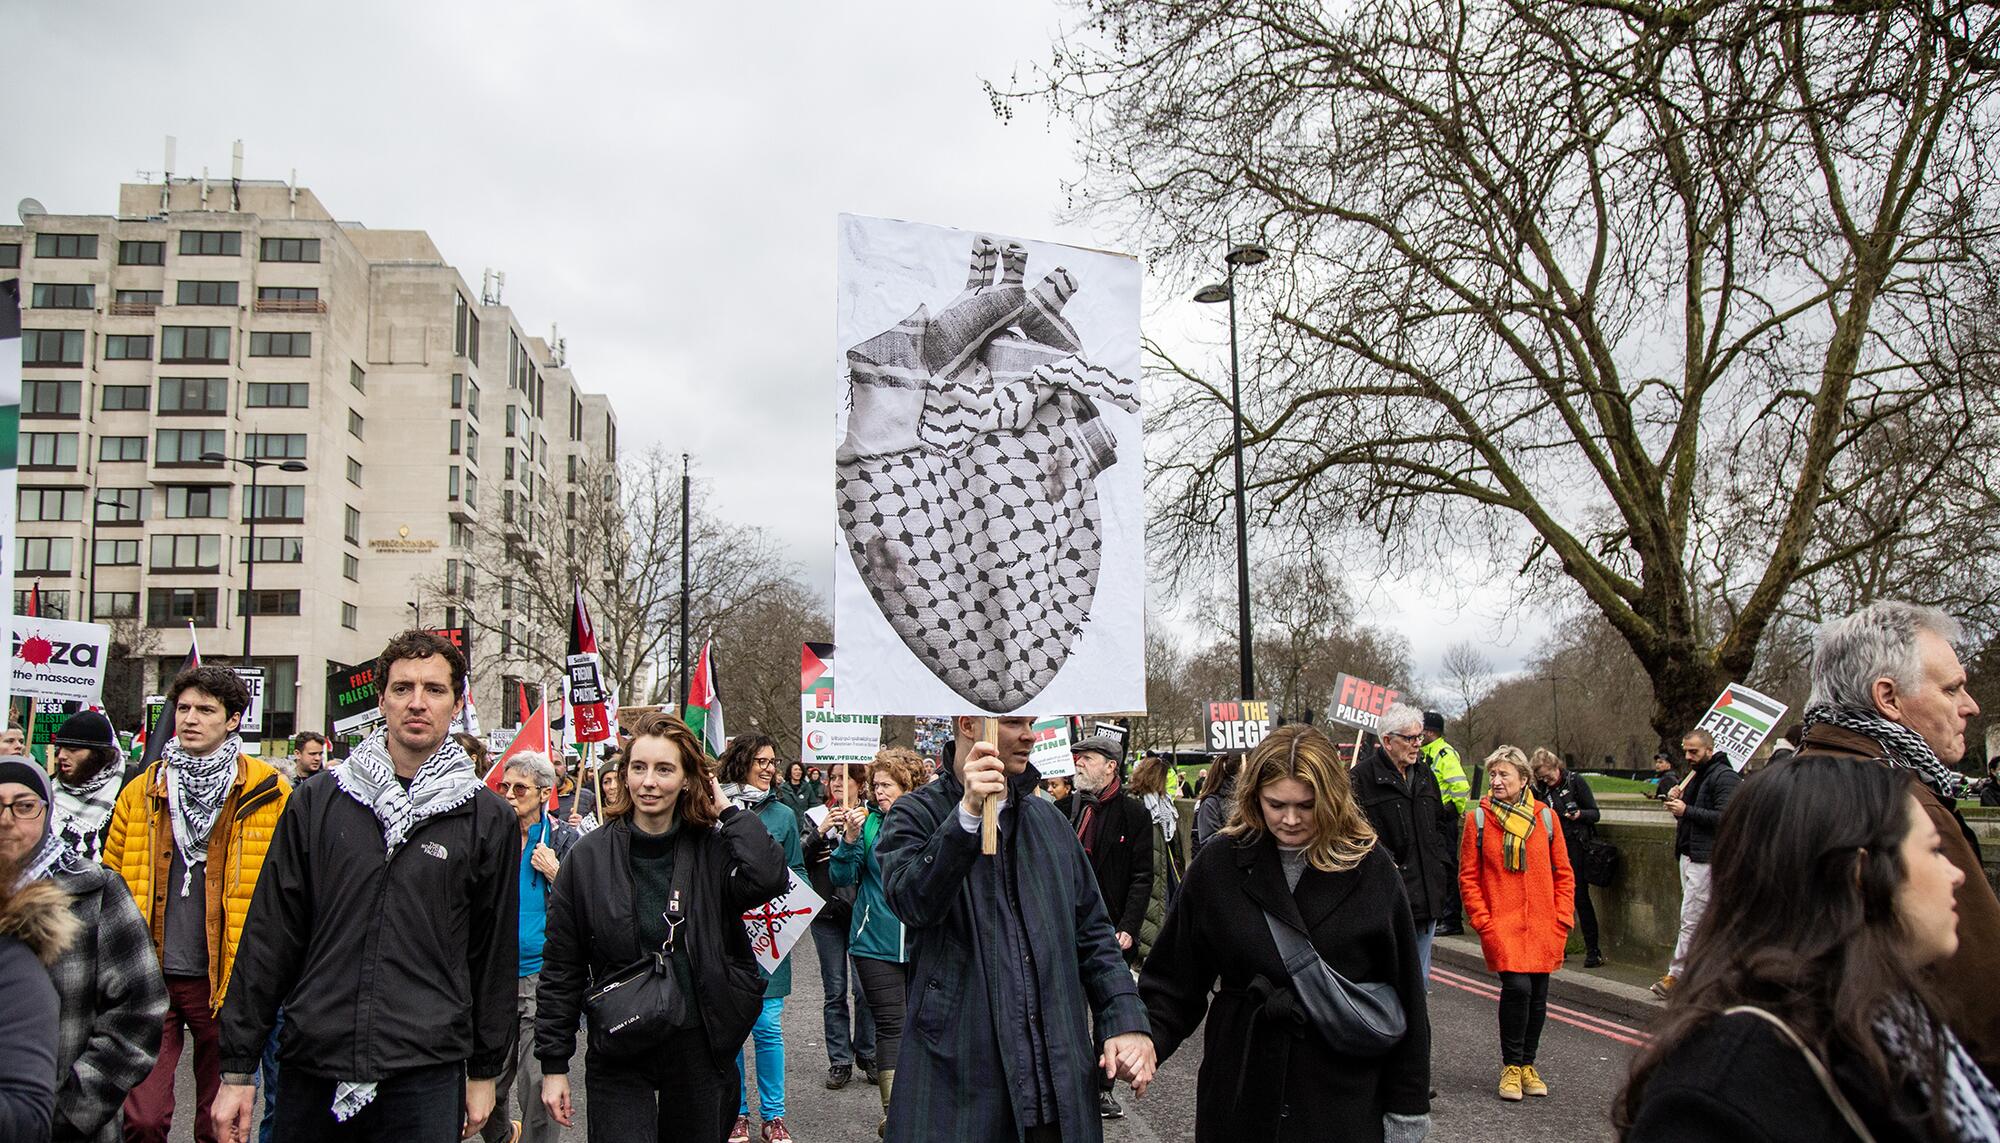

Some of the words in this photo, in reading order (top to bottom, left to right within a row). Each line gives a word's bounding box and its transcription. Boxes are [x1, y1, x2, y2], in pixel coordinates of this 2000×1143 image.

[13, 669, 33, 680] the
[36, 673, 96, 686] massacre
[350, 668, 374, 688] FREE
[339, 683, 374, 706] PALEST
[35, 713, 73, 723] ALESTIN
[36, 703, 47, 713] HE
[48, 704, 64, 714] SEA
[805, 710, 879, 724] PALESTINE
[1209, 702, 1239, 721] END
[1241, 701, 1269, 721] THE
[1336, 703, 1379, 729] PALESTI
[1700, 710, 1764, 750] FREE
